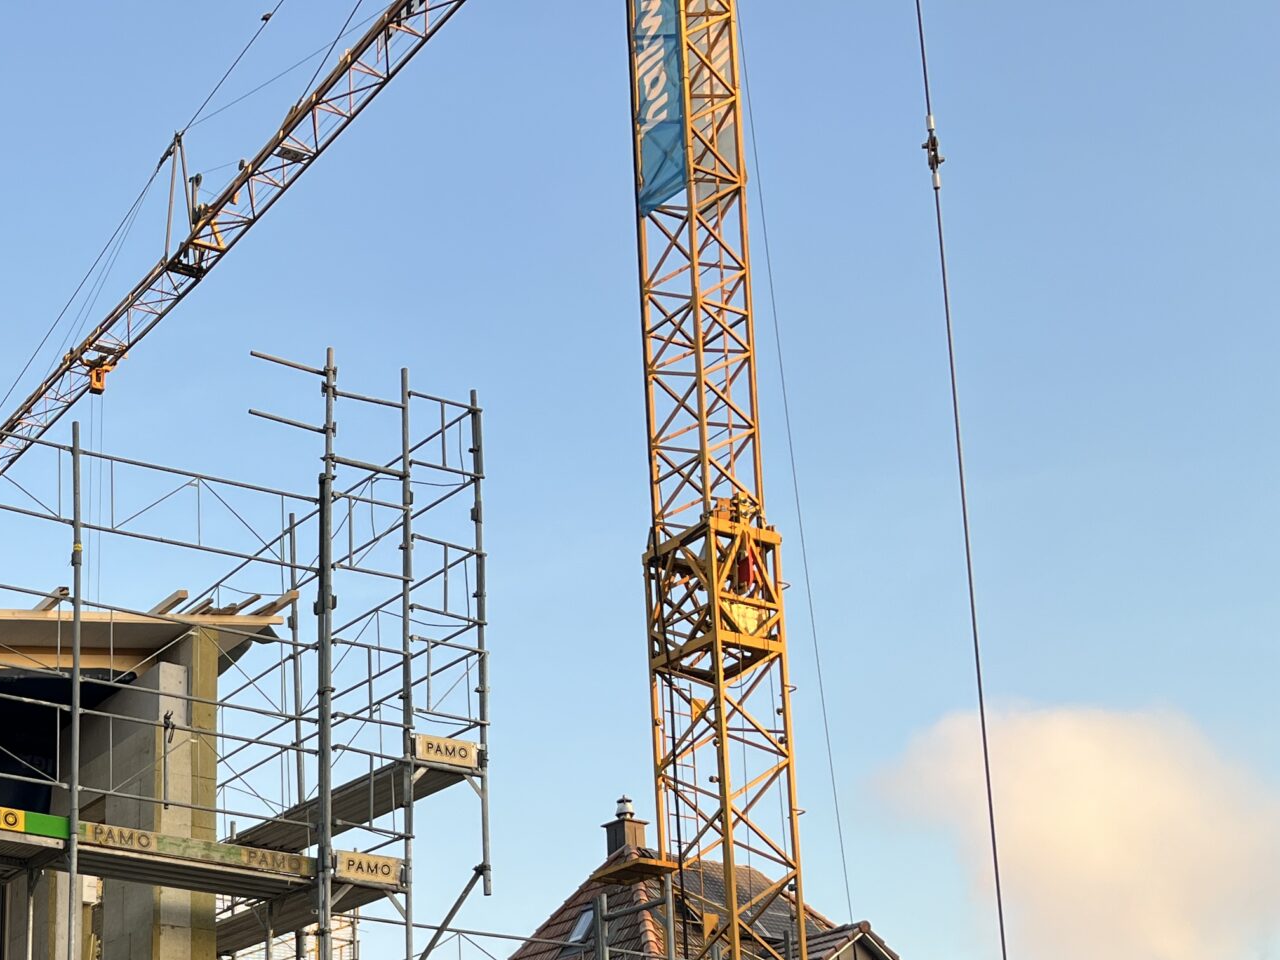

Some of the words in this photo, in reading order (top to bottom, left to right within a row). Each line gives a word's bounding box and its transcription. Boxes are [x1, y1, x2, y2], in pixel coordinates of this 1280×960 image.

[426, 742, 468, 760] PAMO
[94, 825, 151, 850] PAMO
[247, 851, 302, 873] PAMO
[347, 859, 391, 878] PAMO
